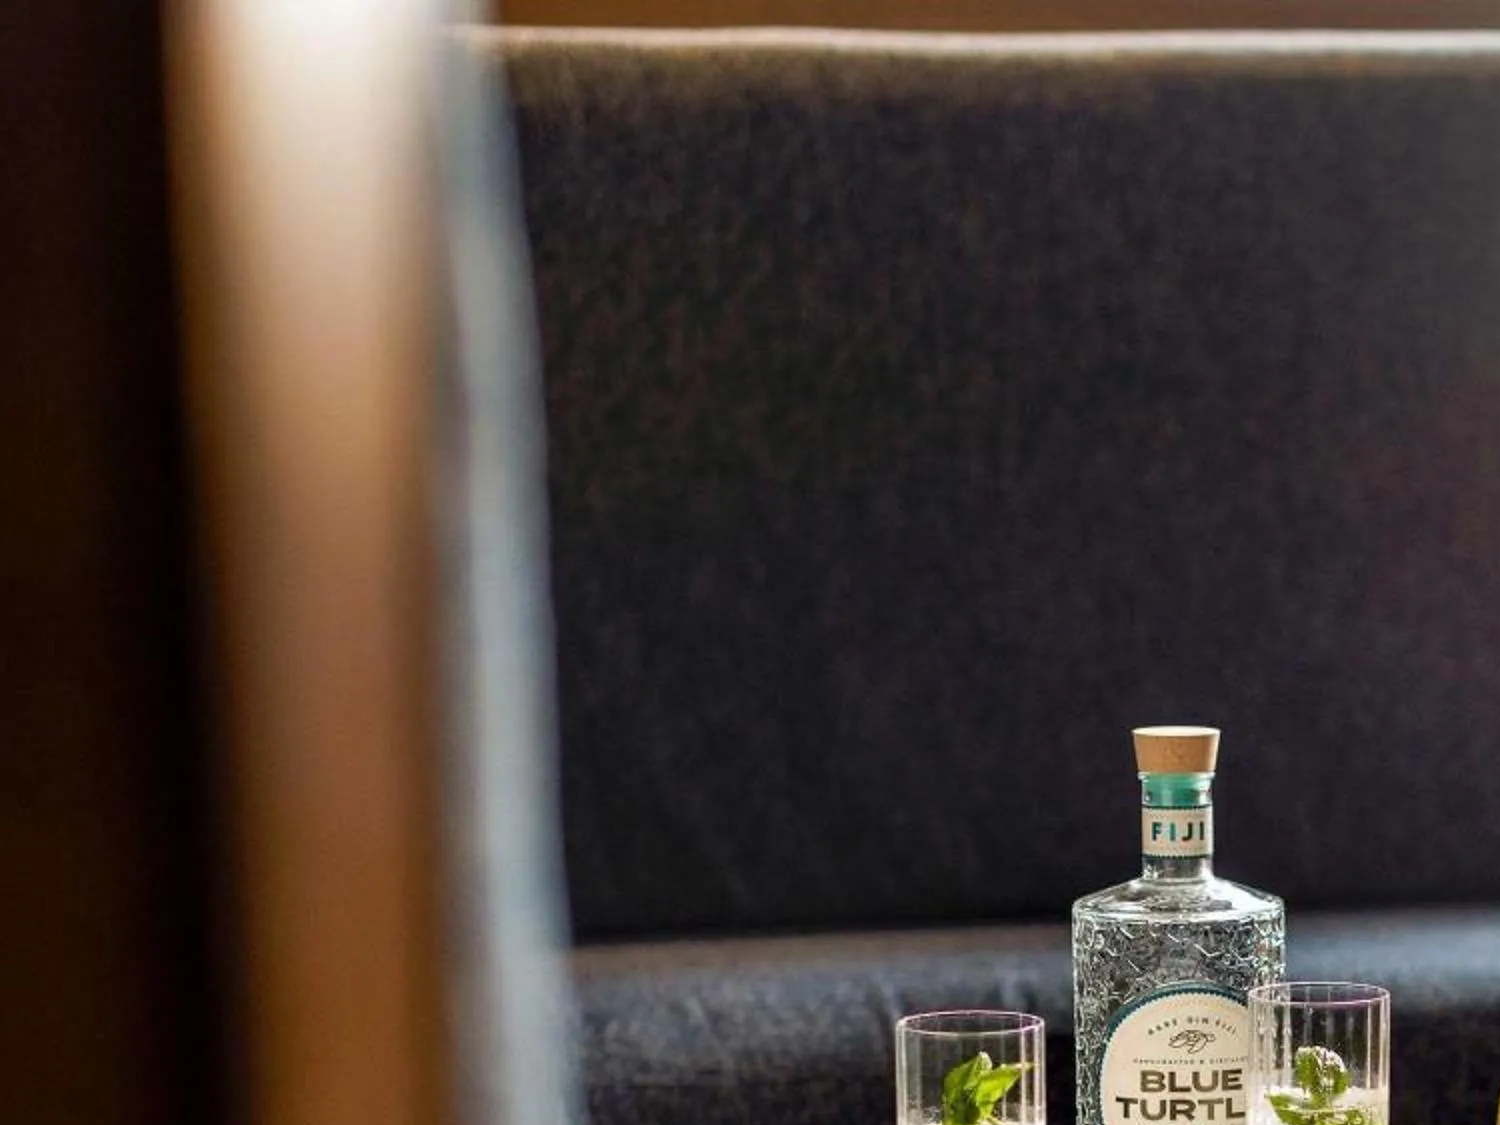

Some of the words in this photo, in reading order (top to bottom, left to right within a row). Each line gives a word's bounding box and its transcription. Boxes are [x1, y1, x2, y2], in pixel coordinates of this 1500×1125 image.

[1151, 820, 1205, 842] FIJI
[1140, 1068, 1243, 1093] BLUE
[1115, 1096, 1246, 1121] TURTL
